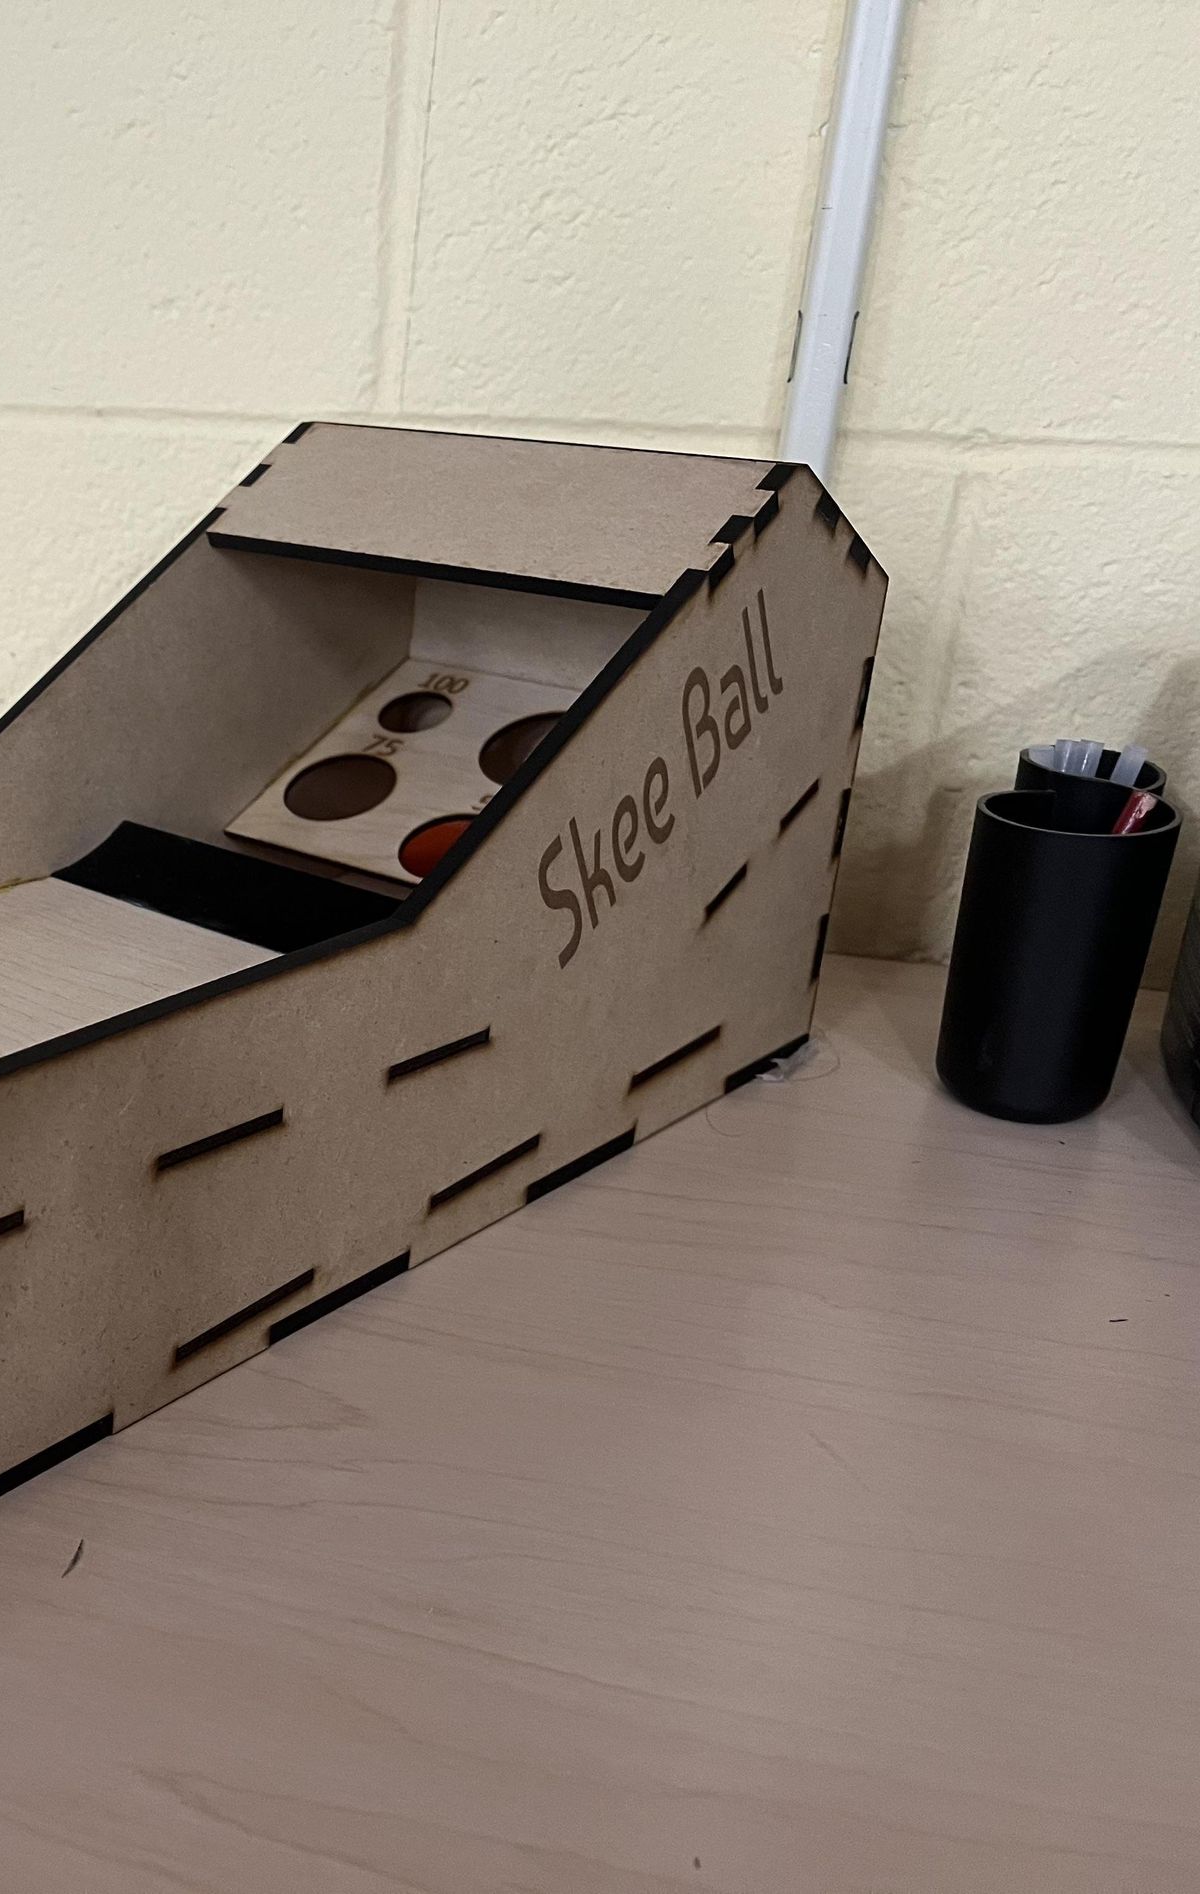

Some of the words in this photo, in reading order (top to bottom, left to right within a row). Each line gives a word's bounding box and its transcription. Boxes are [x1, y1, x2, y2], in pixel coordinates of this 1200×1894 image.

[417, 673, 469, 694] 100
[363, 734, 404, 756] 75
[538, 756, 676, 970] Skee
[681, 587, 783, 800] Ball
